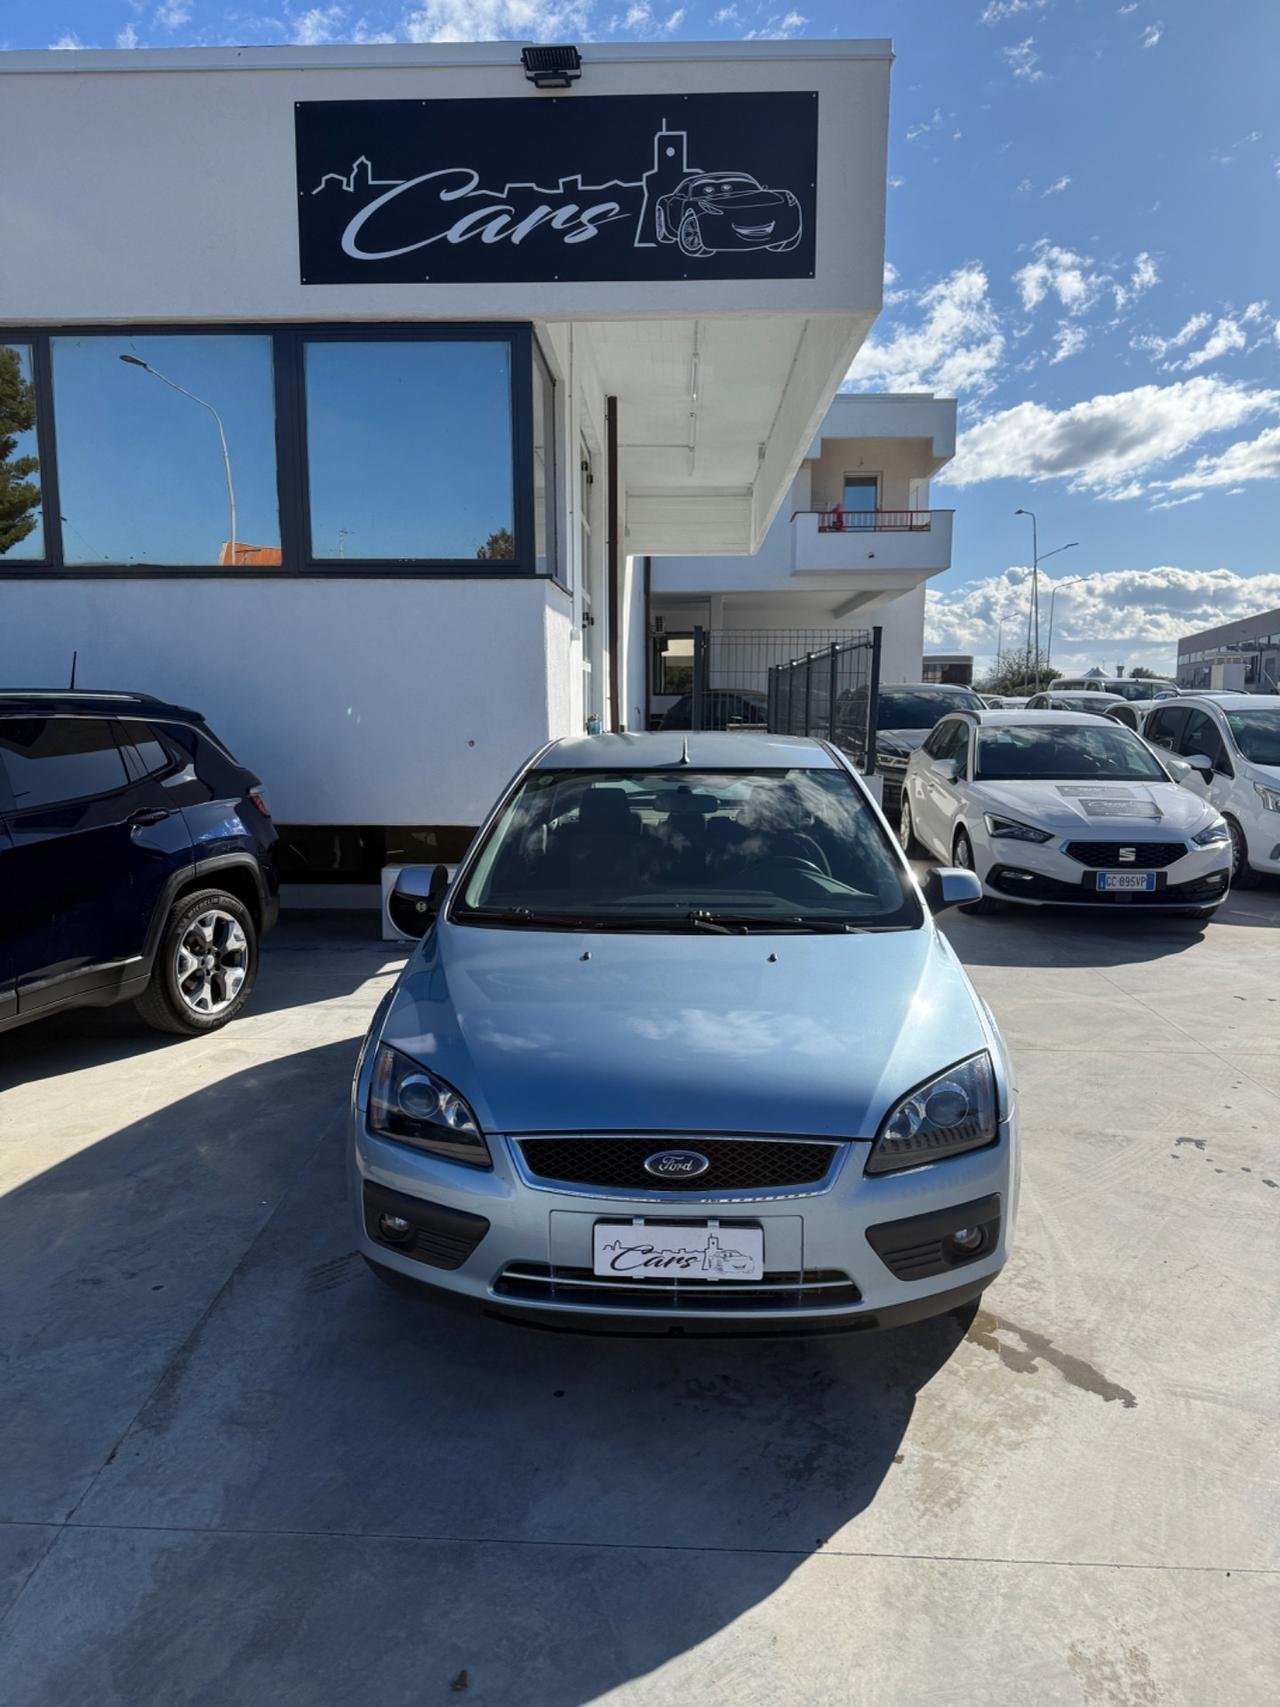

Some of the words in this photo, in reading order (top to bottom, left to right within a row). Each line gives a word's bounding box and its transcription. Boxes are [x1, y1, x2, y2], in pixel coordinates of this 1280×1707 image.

[341, 168, 631, 260] Cars
[658, 1156, 694, 1171] Ford
[610, 1244, 699, 1271] Cars
